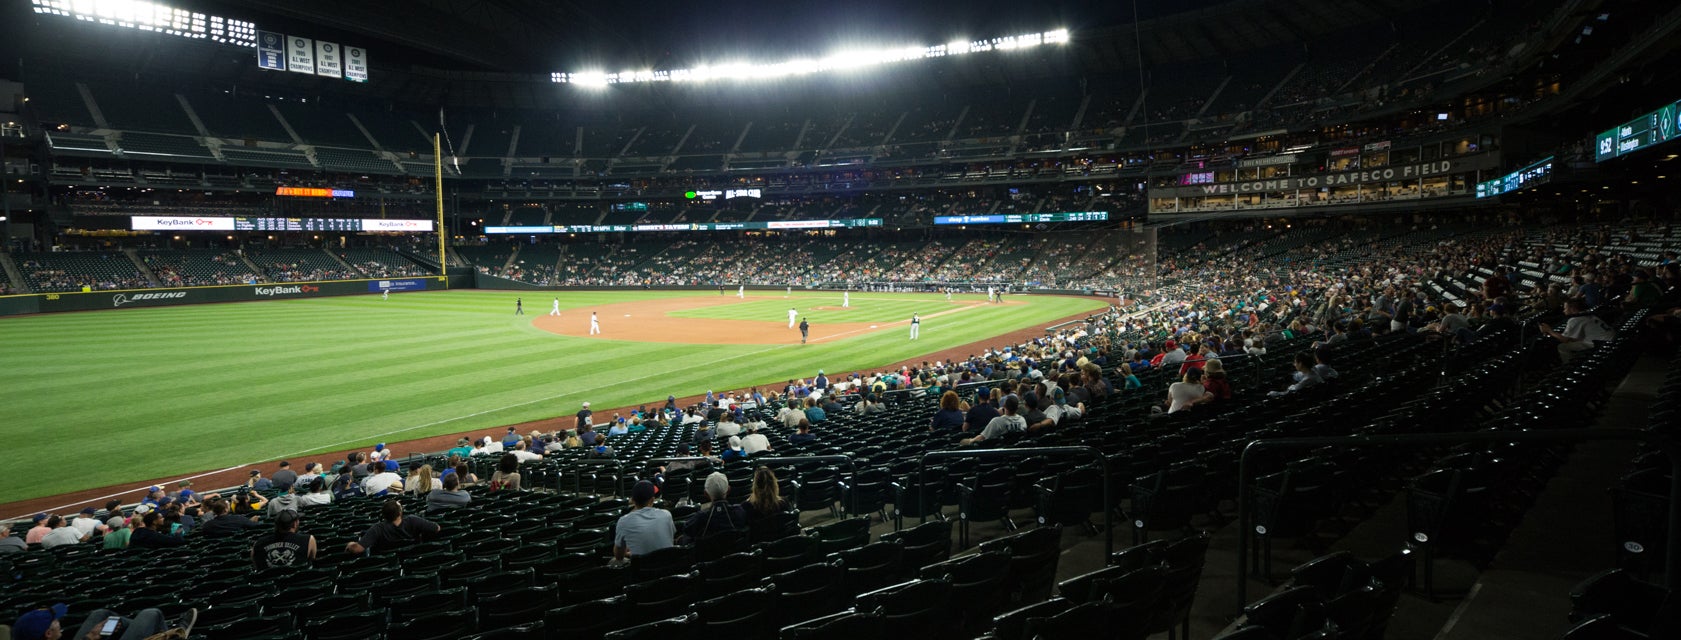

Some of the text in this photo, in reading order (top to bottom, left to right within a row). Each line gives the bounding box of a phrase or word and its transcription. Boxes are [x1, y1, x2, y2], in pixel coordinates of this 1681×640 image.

[290, 63, 313, 72] CHAMPIONS
[1203, 161, 1451, 194] WELCOME TO SAFECO FIELD
[131, 291, 187, 301] BOEING
[255, 286, 301, 296] KeyBank
[284, 542, 300, 551] VALLEY
